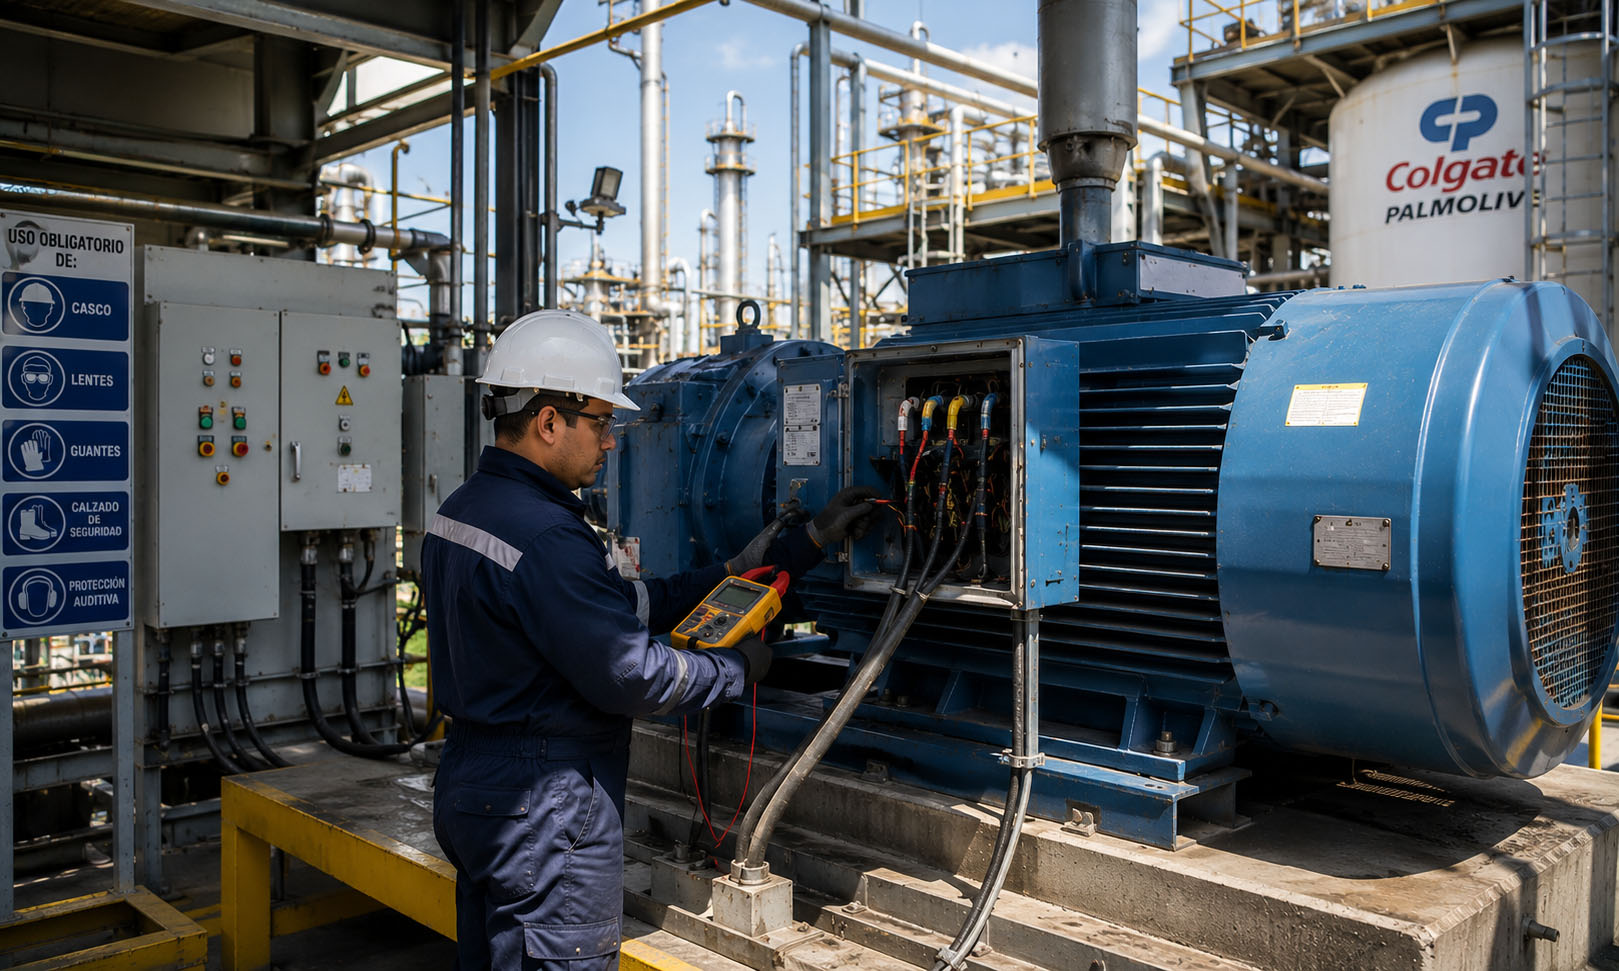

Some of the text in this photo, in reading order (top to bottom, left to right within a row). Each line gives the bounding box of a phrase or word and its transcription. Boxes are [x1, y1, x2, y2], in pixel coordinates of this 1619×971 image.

[8, 228, 124, 254] USO OBLIGATORIO
[56, 253, 77, 268] DE:
[71, 302, 112, 316] CASCO
[71, 373, 114, 387] LENTES
[70, 445, 121, 457] GUANTES
[71, 501, 120, 513] CALZADO
[88, 515, 101, 525] DE
[69, 526, 122, 537] SEGURIDAD
[69, 576, 125, 591] PROTECCIÓN
[73, 594, 120, 608] AUDITIVA
